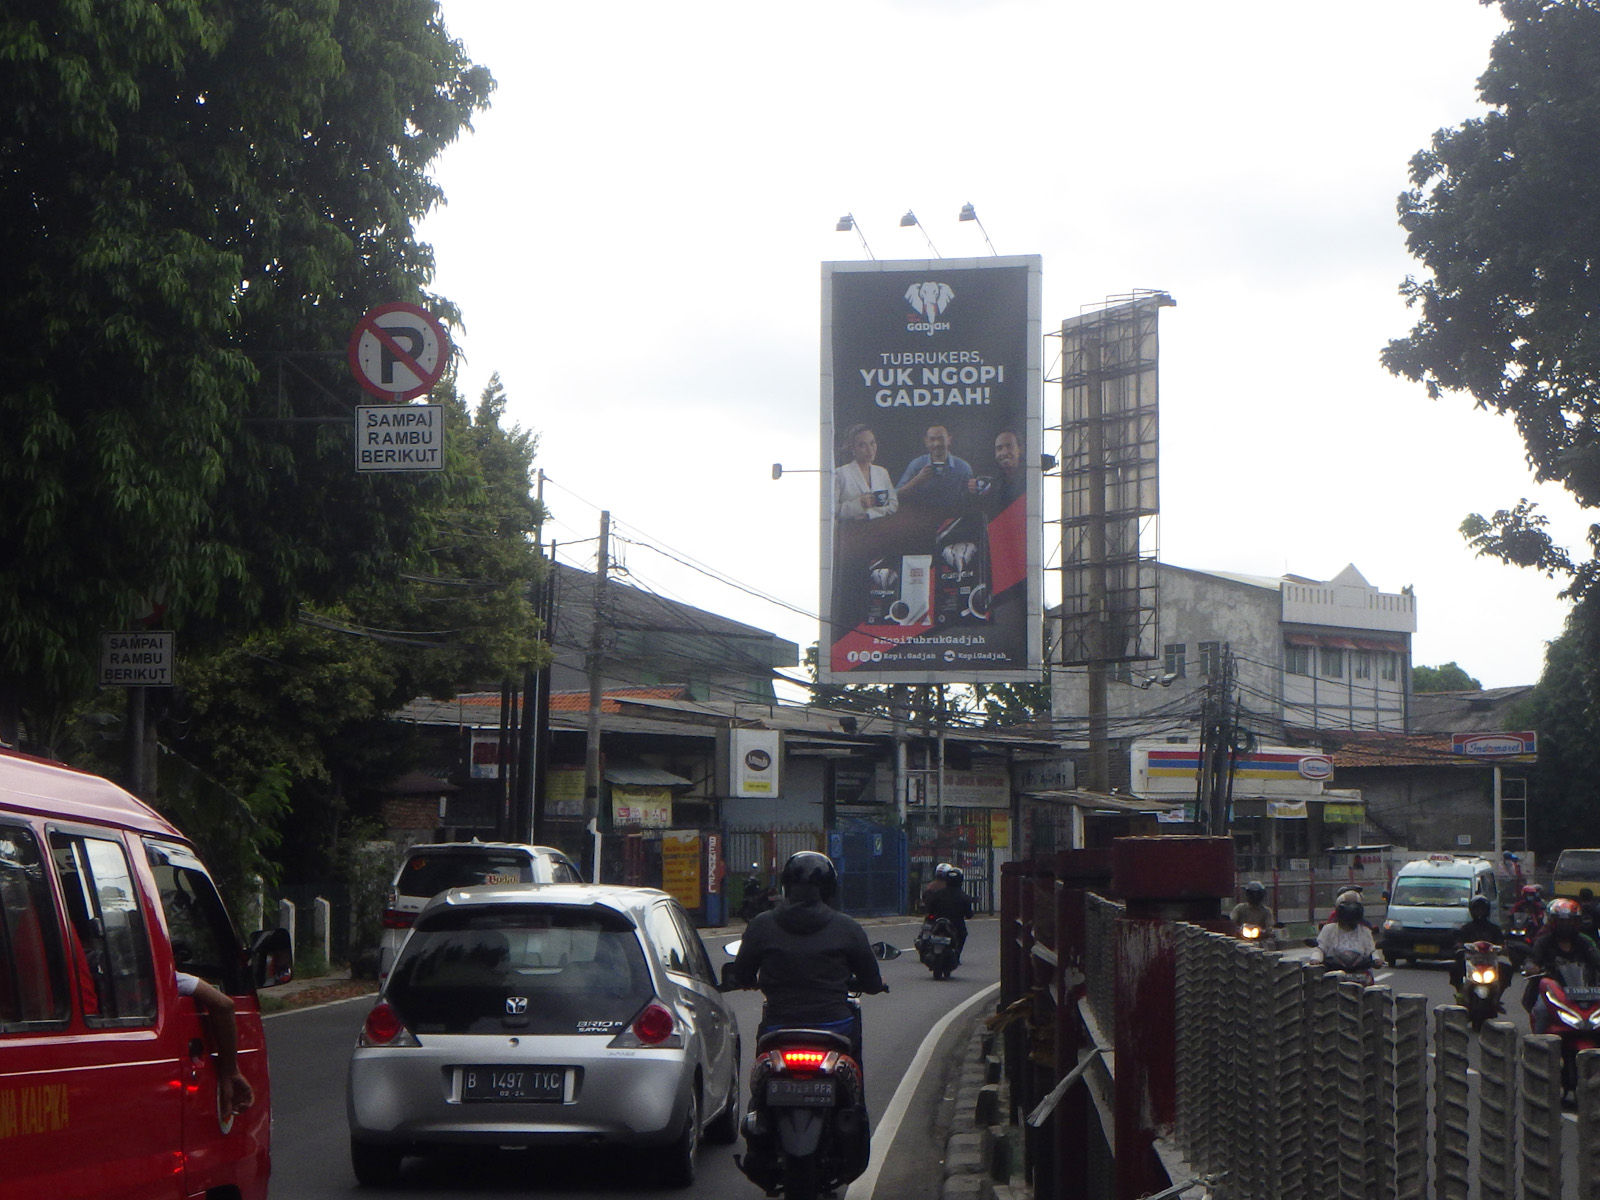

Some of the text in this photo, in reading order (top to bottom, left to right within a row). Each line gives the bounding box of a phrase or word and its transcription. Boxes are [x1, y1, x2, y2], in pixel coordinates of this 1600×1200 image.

[880, 351, 984, 365] TUBRUKERS,
[859, 365, 1004, 387] YUK NGOPI
[875, 387, 991, 408] GADJAH!
[367, 411, 433, 428] SAMPAI
[367, 431, 433, 445] RAMBU
[361, 449, 438, 464] BERIKUT
[110, 638, 163, 649] SAMPAI
[110, 653, 162, 664] RAMBU
[104, 668, 167, 680] BERIKUT
[1468, 742, 1520, 753] Indomaret
[468, 1073, 477, 1088] B
[491, 1073, 524, 1089] 1497
